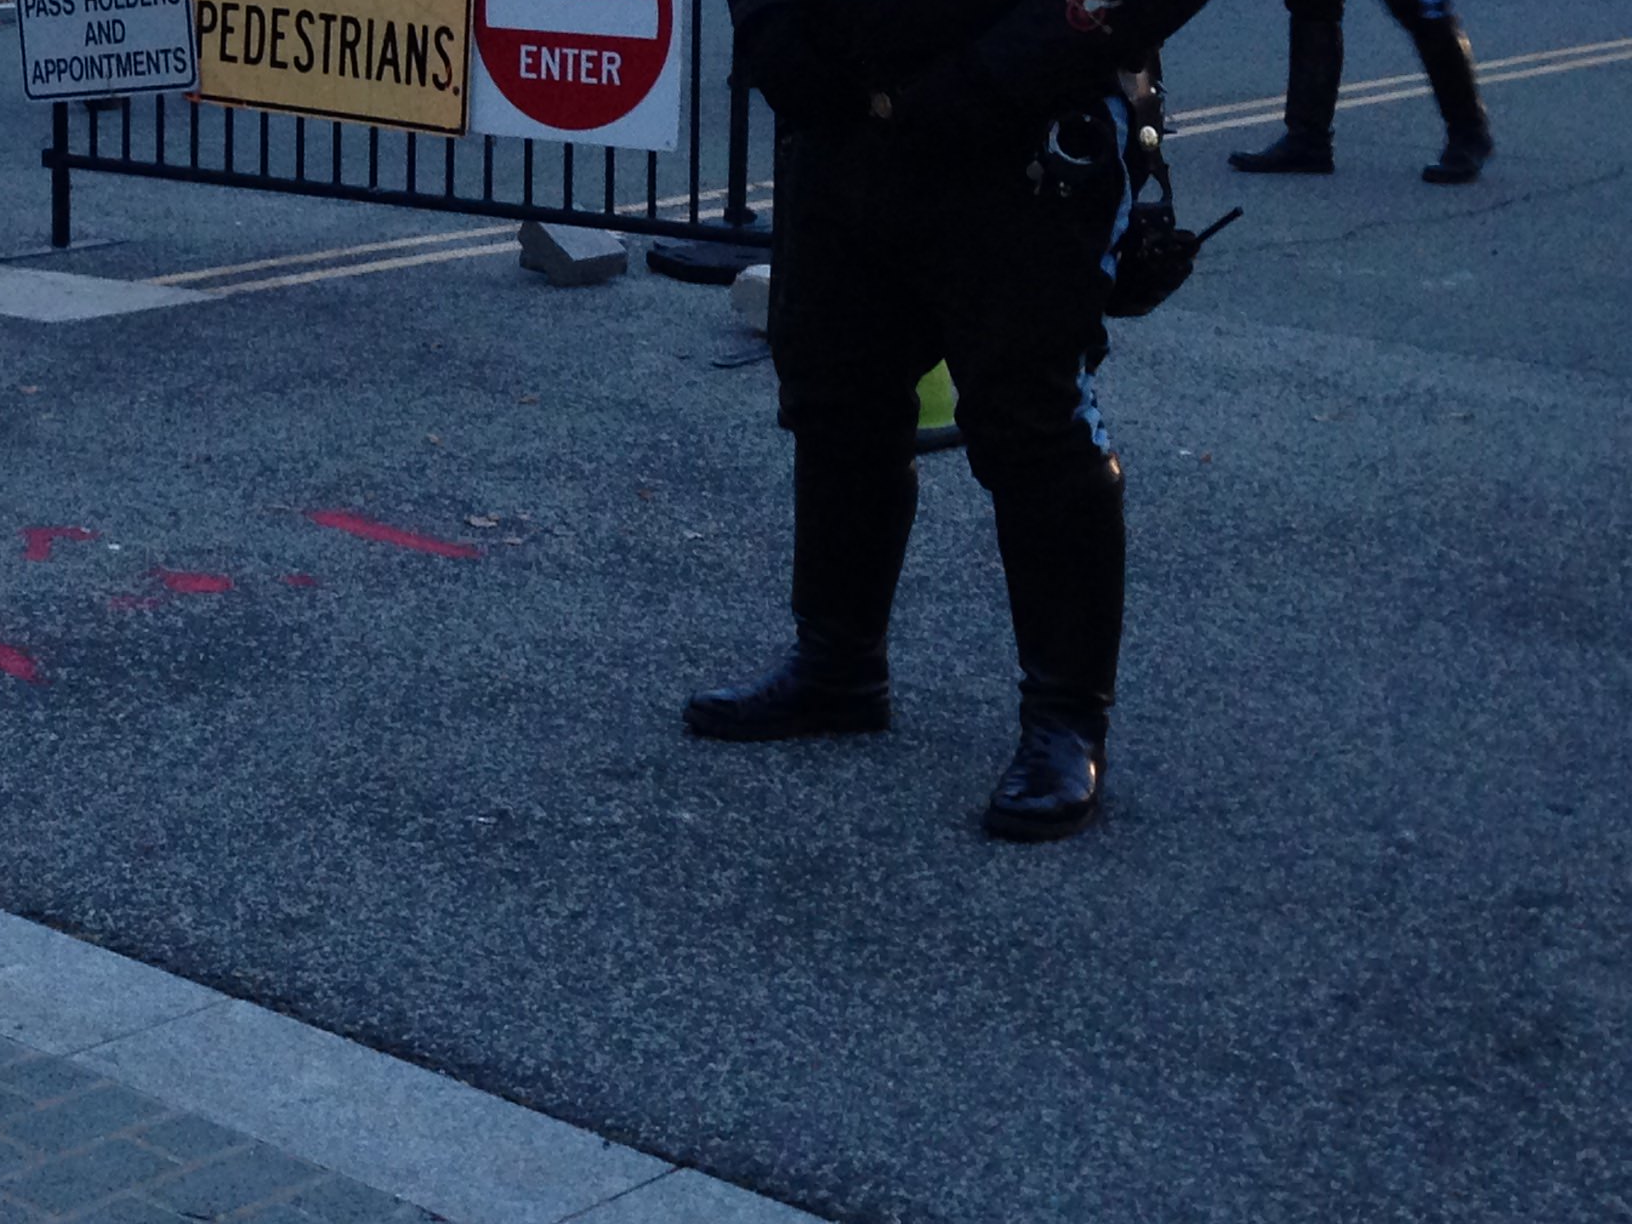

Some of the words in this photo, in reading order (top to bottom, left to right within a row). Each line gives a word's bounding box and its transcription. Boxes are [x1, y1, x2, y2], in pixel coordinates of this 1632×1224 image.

[85, 19, 126, 46] AND
[32, 47, 187, 85] APPOINTMENTS
[519, 44, 622, 86] ENTER
